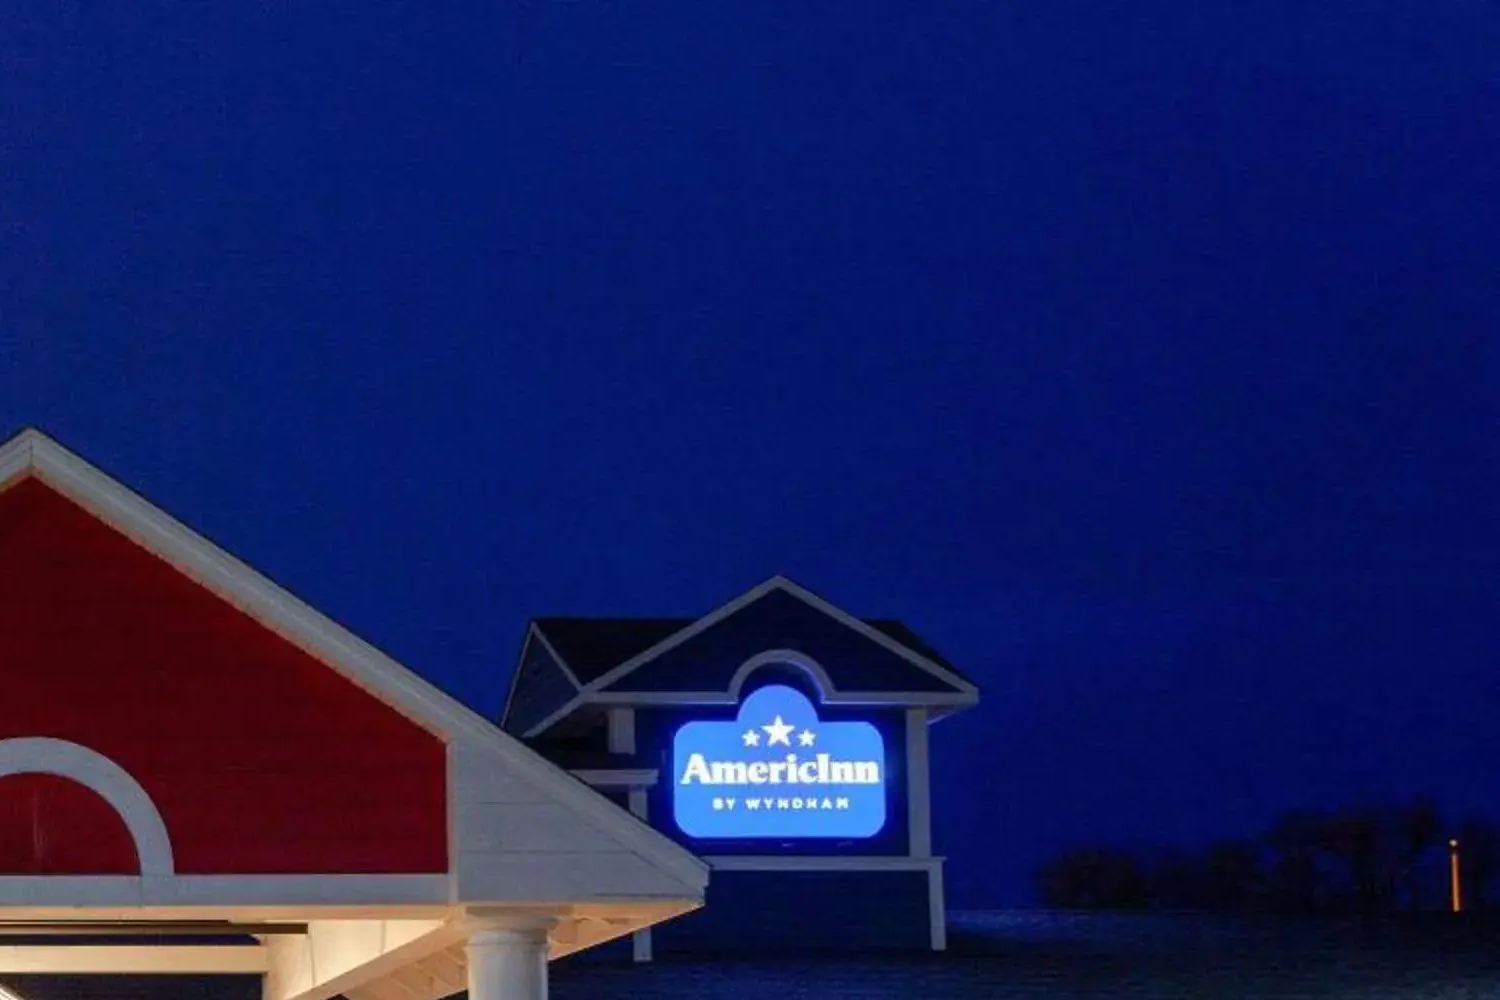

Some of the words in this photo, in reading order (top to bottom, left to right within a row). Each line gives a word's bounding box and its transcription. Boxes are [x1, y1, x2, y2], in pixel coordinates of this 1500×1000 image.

[680, 753, 880, 785] AmericInn
[712, 797, 736, 811] BY
[745, 797, 850, 811] WYNDHAM
